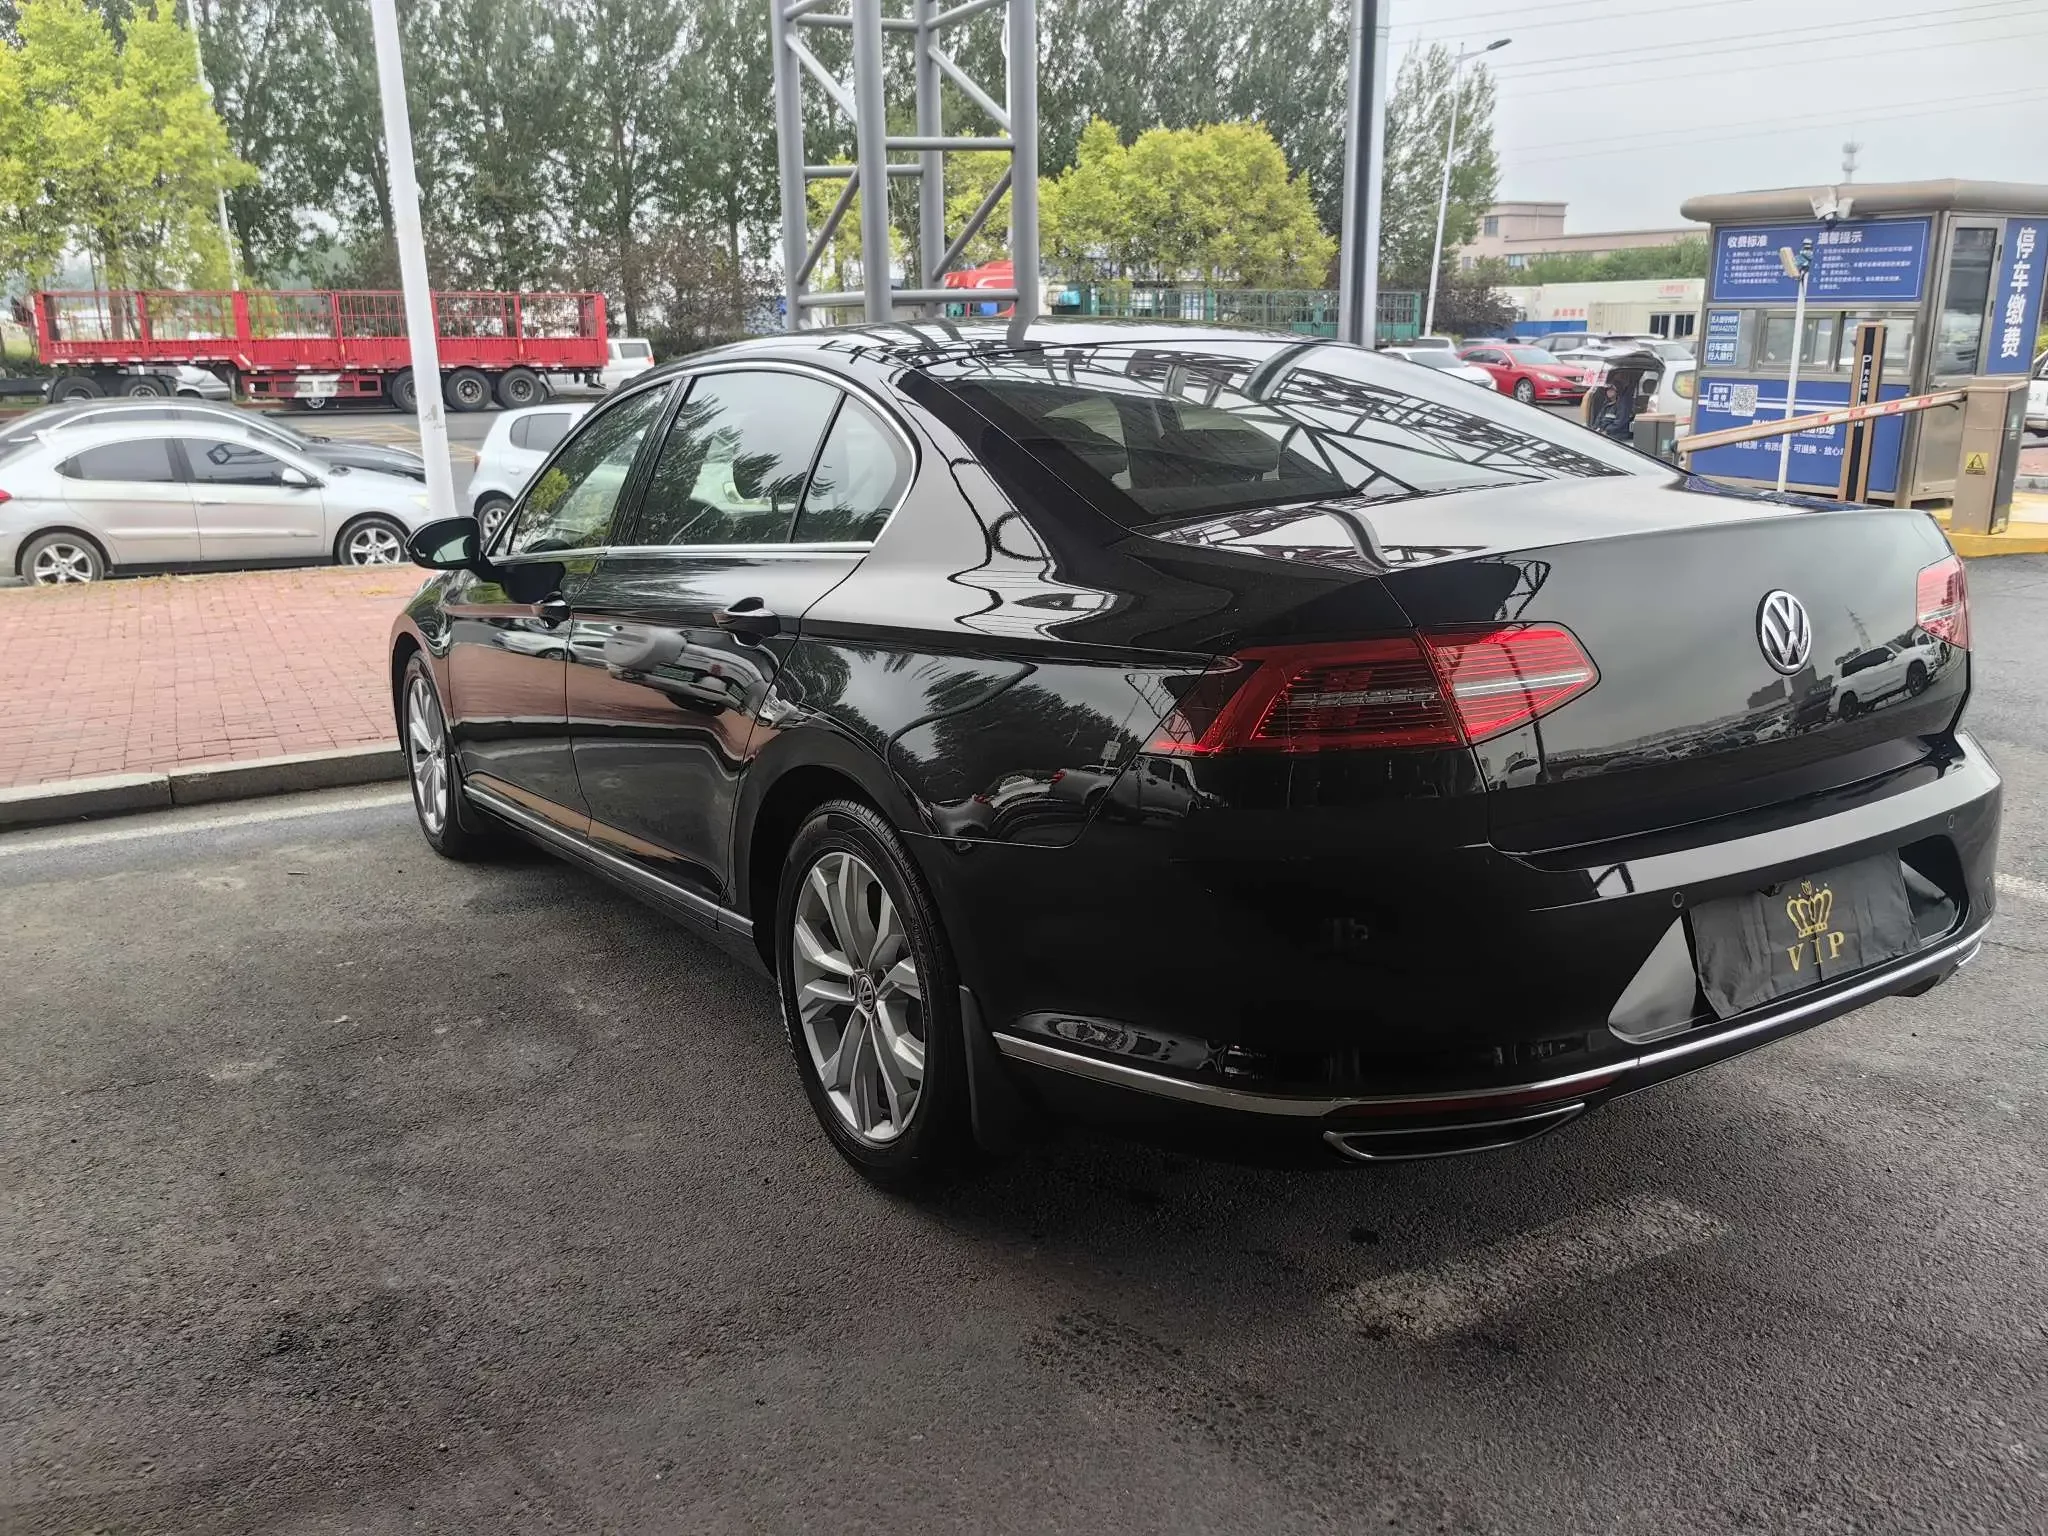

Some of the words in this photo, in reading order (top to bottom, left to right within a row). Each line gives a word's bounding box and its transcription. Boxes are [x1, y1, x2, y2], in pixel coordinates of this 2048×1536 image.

[1727, 235, 1768, 248] 收费标准
[1817, 231, 1863, 245] 温馨提示
[2001, 227, 2036, 358] 停车缴费
[1786, 931, 1845, 972] VIP
